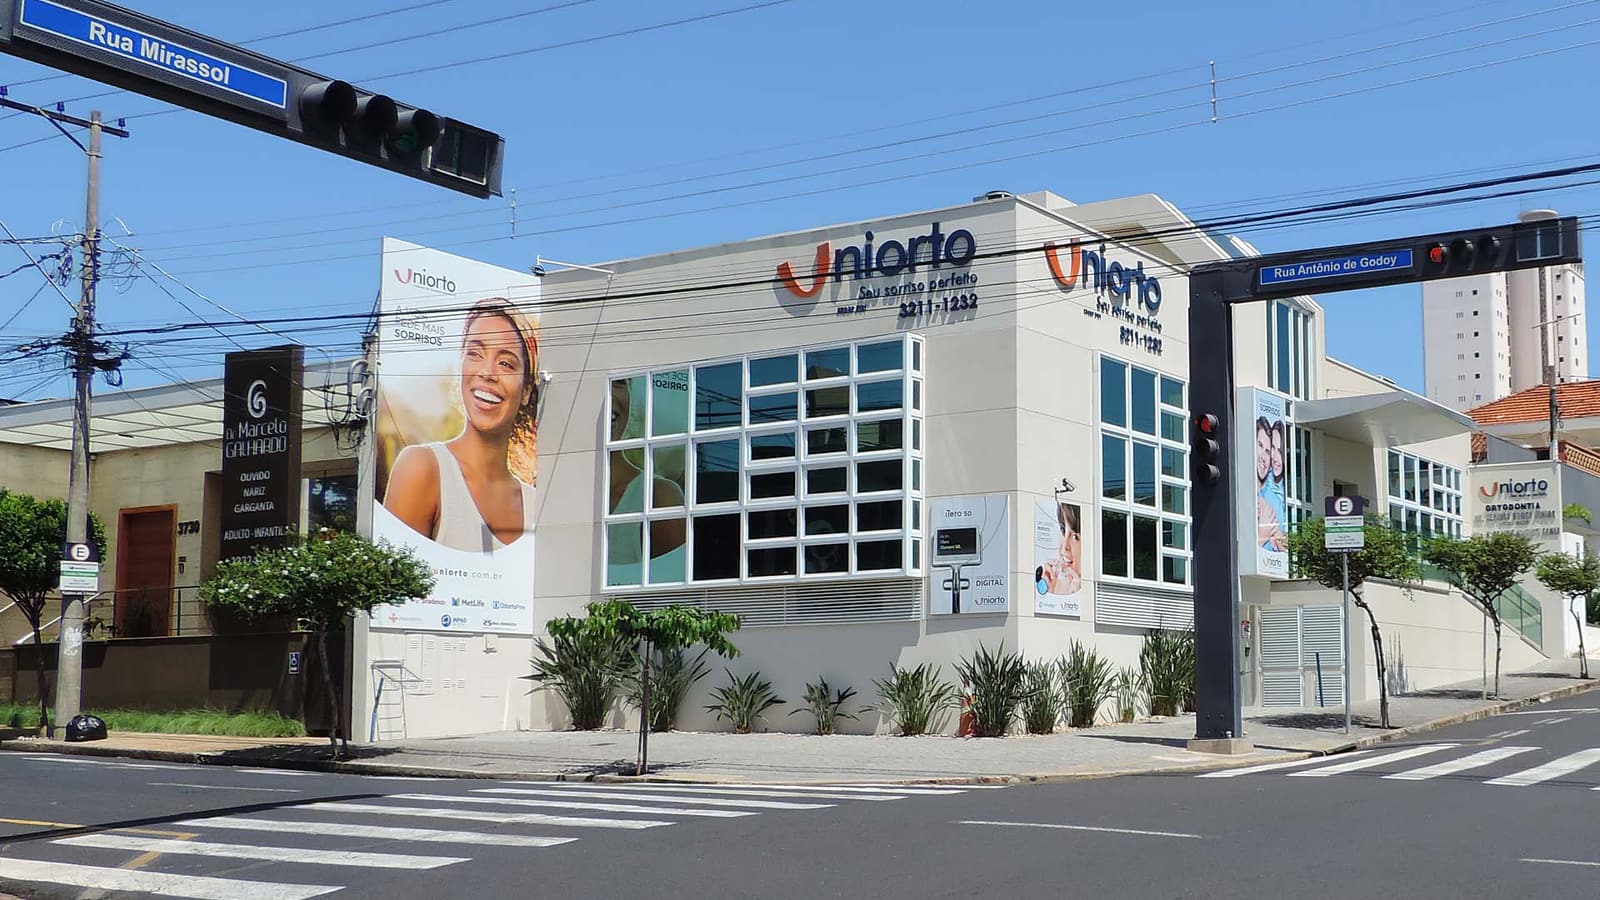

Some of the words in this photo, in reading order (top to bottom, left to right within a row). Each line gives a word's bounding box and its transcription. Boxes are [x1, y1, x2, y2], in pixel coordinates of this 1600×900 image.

[88, 21, 134, 53] Rua
[140, 38, 230, 84] Mirassol
[776, 222, 976, 298] Uniorto
[1274, 266, 1296, 278] Rua
[1298, 261, 1342, 276] Antônio
[1343, 258, 1357, 269] de
[1359, 254, 1398, 269] Godoy
[394, 268, 456, 293] Uniorto
[1043, 237, 1162, 312] Uniorto
[858, 285, 881, 300] Seu
[884, 281, 925, 295] sorriso
[929, 271, 978, 291] perfeito
[899, 293, 978, 318] 3211-1232
[394, 328, 443, 347] SORRISOS
[238, 417, 288, 440] Marcelo
[225, 436, 287, 458] GALHARDO
[240, 470, 271, 483] OUVIDO
[243, 487, 266, 498] NARIZ
[1480, 478, 1548, 498] Uniorto
[233, 501, 275, 514] GARGANTA
[1340, 501, 1348, 511] E
[1485, 502, 1540, 511] ORTODONTIA
[223, 528, 250, 541] ADULTO
[77, 547, 85, 557] E
[975, 579, 1004, 587] DIGITAL
[461, 598, 485, 607] MetLife
[974, 595, 1006, 606] Uniorto
